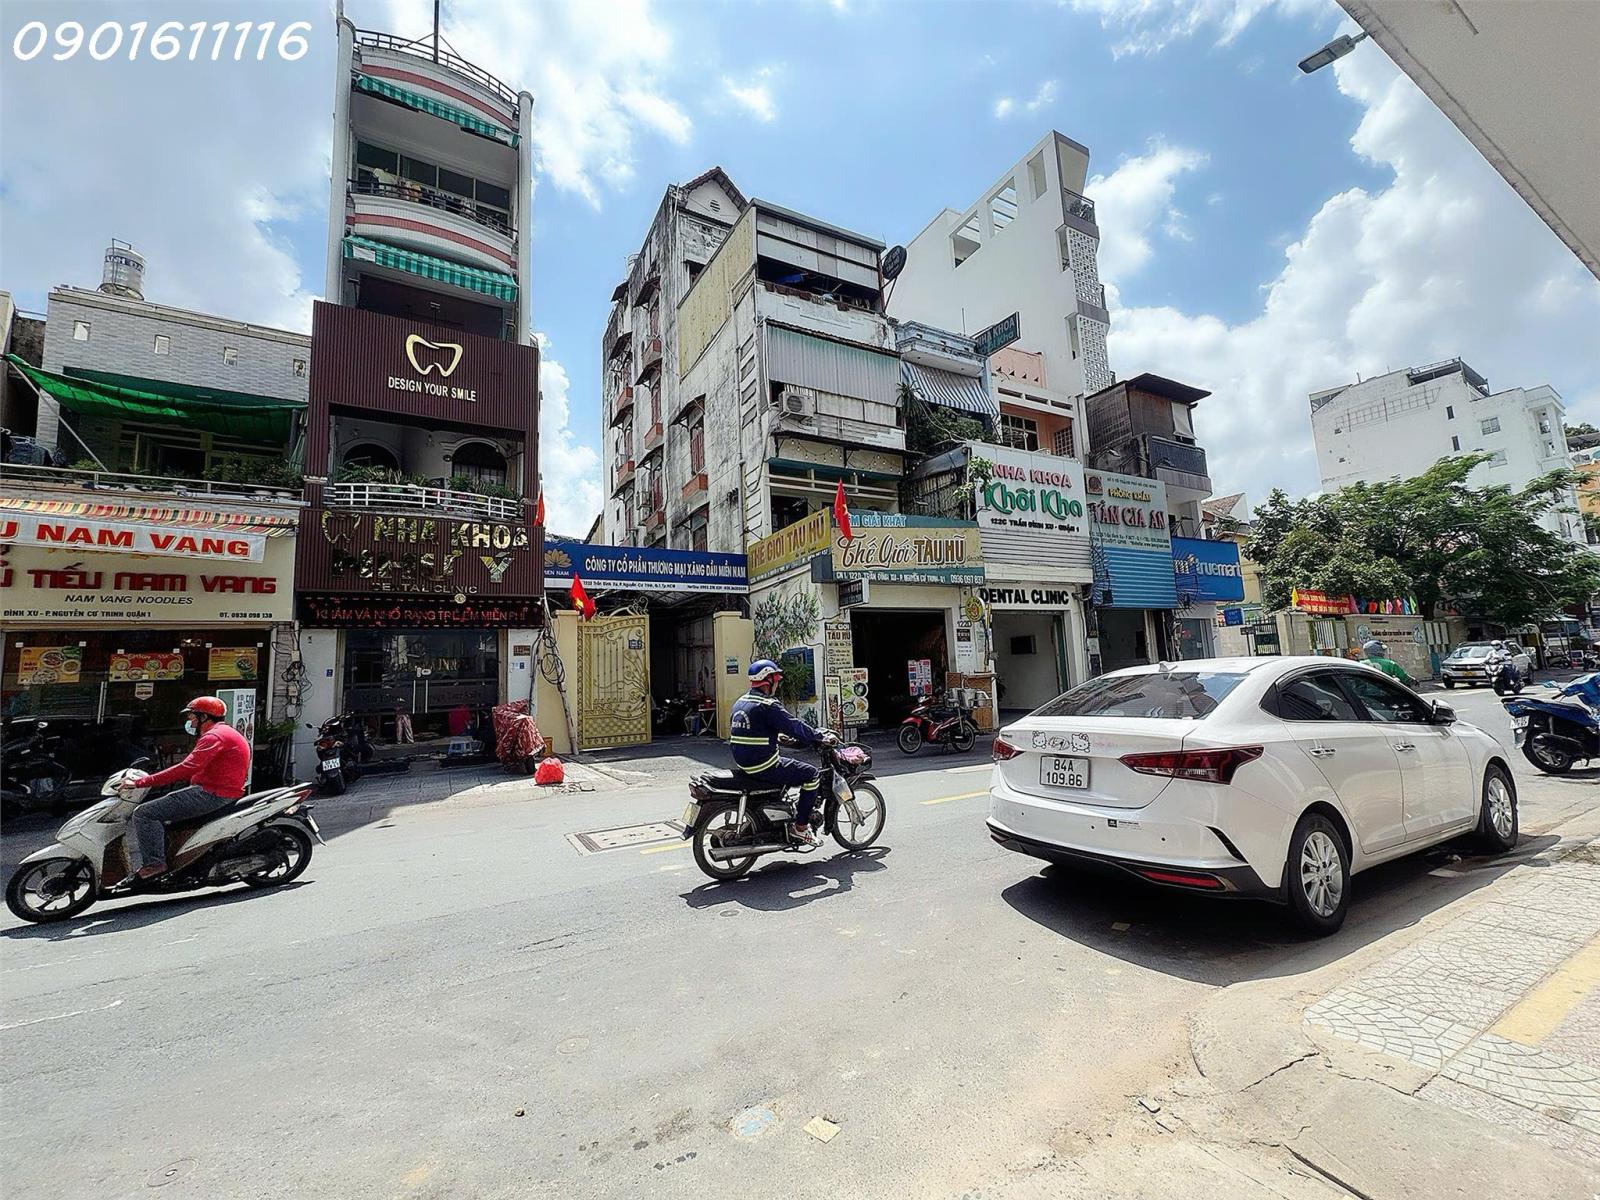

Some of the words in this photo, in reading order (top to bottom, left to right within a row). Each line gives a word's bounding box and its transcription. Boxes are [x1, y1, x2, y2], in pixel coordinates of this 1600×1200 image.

[992, 317, 1015, 338] KHOA
[388, 376, 422, 393] DESIGN
[424, 383, 449, 398] YOUR
[451, 387, 477, 402] SMILE
[992, 463, 1027, 482] NHA
[1029, 468, 1072, 489] KHOA
[983, 481, 1037, 515] Khôi
[861, 511, 882, 528] GIẢI
[1149, 509, 1166, 529] AN
[36, 523, 136, 549] NAM
[149, 533, 251, 557] VANG
[450, 522, 530, 551] KHOA
[913, 535, 944, 566] TÀU
[944, 534, 968, 565] HŨ
[585, 555, 607, 572] CÔNG
[608, 559, 616, 573] TY
[616, 553, 627, 573] CỔ
[628, 554, 647, 574] PHẦN
[648, 560, 674, 576] THƯƠNG
[674, 562, 687, 578] MẠI
[687, 561, 705, 577] XĂNG
[733, 566, 746, 578] NAM
[1196, 558, 1242, 578] truemart
[27, 562, 103, 590] TIẾU
[113, 571, 187, 592] NAM
[200, 574, 277, 594] VANG
[64, 594, 95, 602] NAM
[100, 595, 132, 603] VANG
[136, 596, 193, 605] NOODLES
[980, 588, 1030, 604] DENTAL
[1030, 589, 1069, 605] CLINIC
[1053, 759, 1074, 772] 84A
[1046, 771, 1083, 787] 109.86
